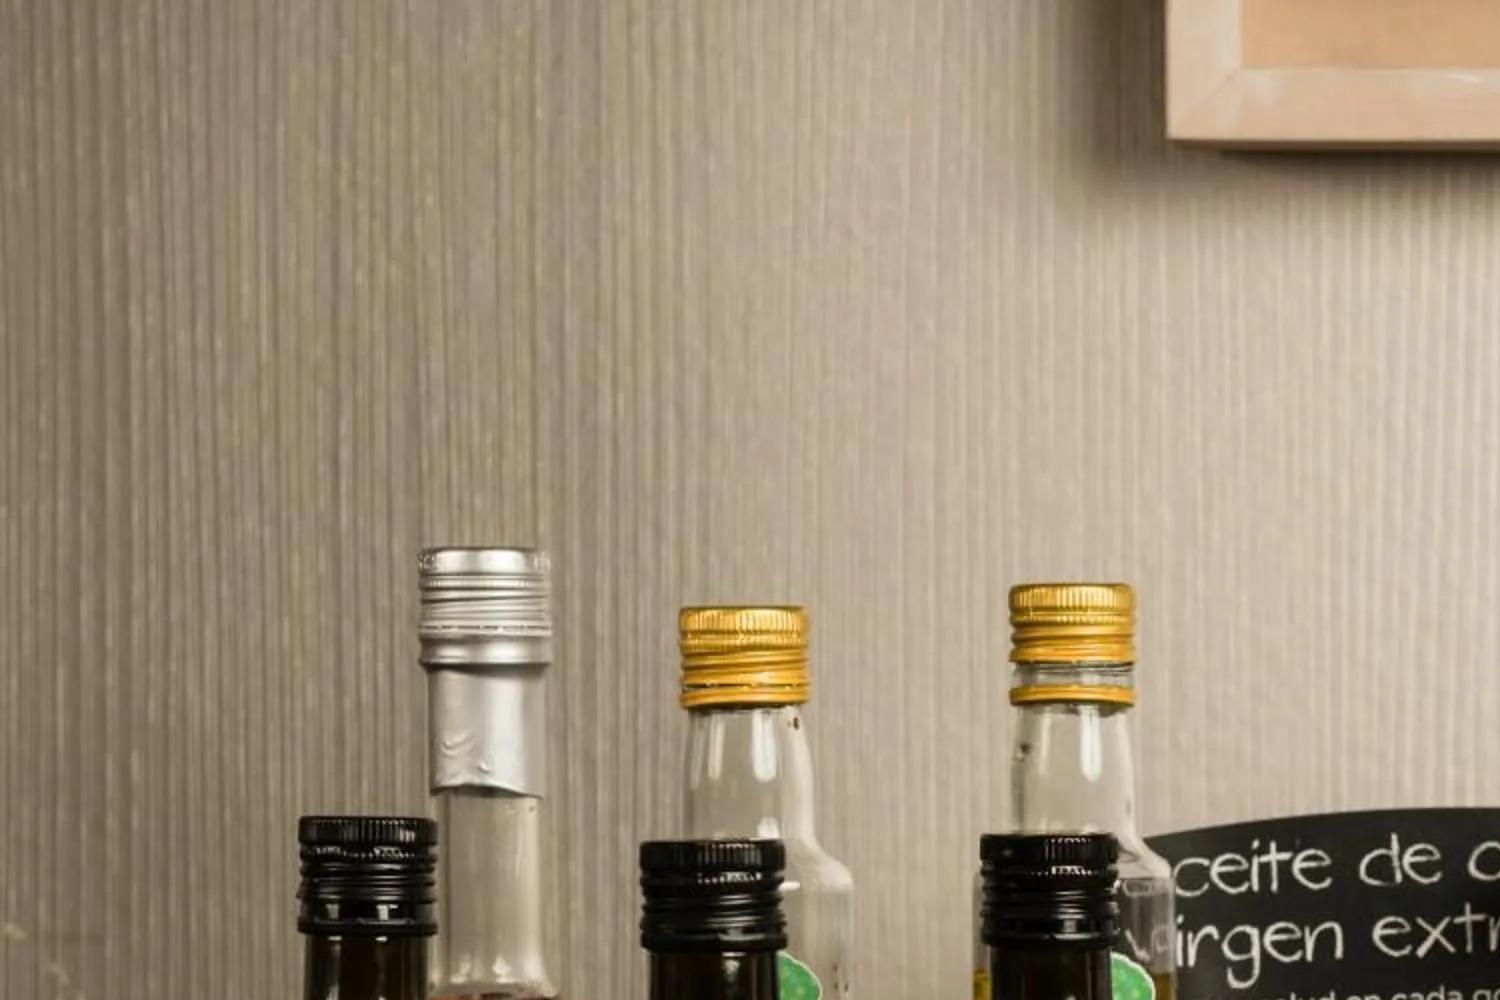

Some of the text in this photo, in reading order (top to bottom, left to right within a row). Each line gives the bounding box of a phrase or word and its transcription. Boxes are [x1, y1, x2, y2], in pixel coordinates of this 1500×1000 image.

[1171, 838, 1333, 897] ceite
[1359, 833, 1444, 886] de
[1175, 914, 1344, 989] irgen
